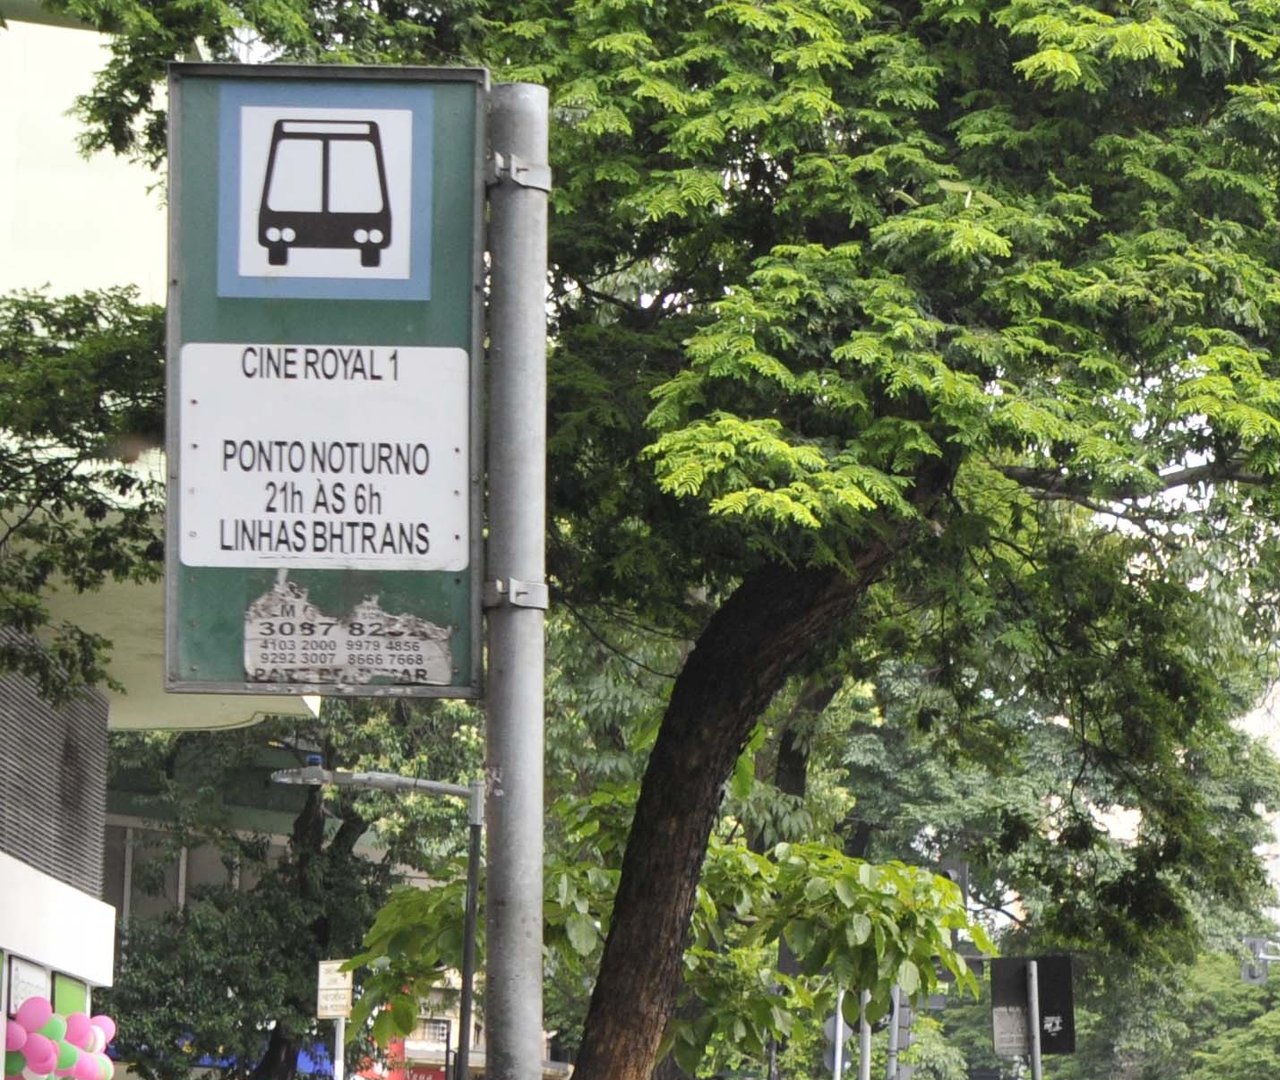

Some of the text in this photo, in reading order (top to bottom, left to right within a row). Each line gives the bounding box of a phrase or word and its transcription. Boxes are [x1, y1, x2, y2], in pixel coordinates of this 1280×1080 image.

[242, 347, 399, 381] CINE ROYAL 1
[222, 440, 430, 475] PONTO NOTURNO
[265, 478, 382, 515] 21h ÀS 6h
[220, 519, 430, 555] LINHAS BHTRANS
[302, 640, 337, 650] 2000
[349, 622, 433, 639] 82
[260, 653, 297, 664] 9292
[302, 653, 336, 664] 3007
[388, 654, 424, 665] 7668
